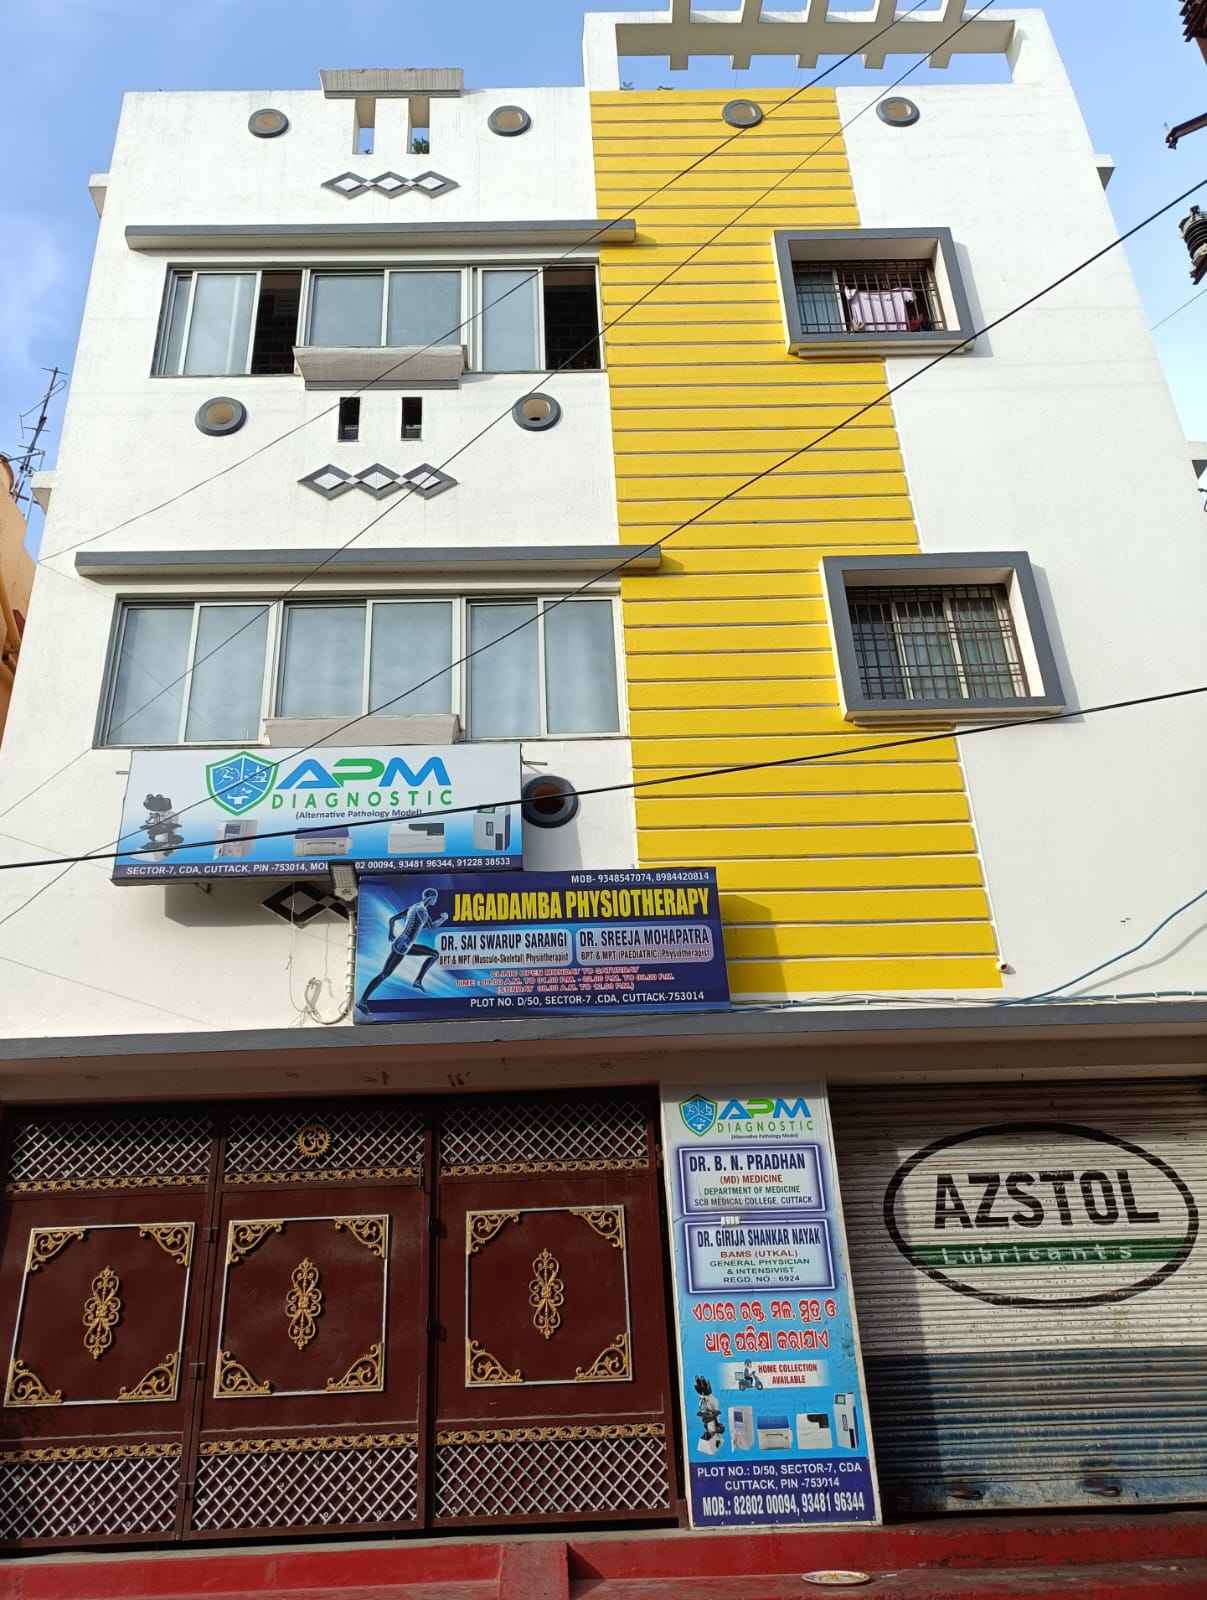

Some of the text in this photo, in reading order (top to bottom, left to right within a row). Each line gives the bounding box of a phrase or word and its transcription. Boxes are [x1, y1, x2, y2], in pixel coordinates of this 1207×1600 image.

[276, 756, 452, 789] APM
[272, 790, 453, 810] DIAGNOSTIC
[295, 810, 346, 820] (Alternative
[348, 810, 390, 819] Pathology
[126, 866, 176, 876] SECTOR-7,
[252, 864, 269, 872] PIN
[270, 862, 308, 872] -753014,
[368, 861, 396, 870] 00094,
[398, 860, 424, 869] 93481
[426, 859, 455, 868] 96344,
[456, 858, 483, 867] 91228
[484, 857, 511, 866] 38533
[571, 872, 709, 884] MOB- 9348547074, 8984420814
[452, 888, 708, 922] JAGADAMBA PHYSIOTHERAPY
[440, 932, 567, 951] DR. SAI SWARUP SARANGI
[580, 928, 710, 946] DR. SREEJA MOHAPATRA
[470, 998, 495, 1008] PLOT
[497, 997, 514, 1007] NO.
[517, 996, 542, 1006] D/50,
[545, 994, 592, 1005] SECTOR-7
[622, 992, 704, 1002] CUTTACK-753014
[718, 1097, 812, 1120] APM
[717, 1120, 814, 1133] DIAGNOSTIC
[689, 1153, 806, 1172] DR. B. N. PRADHAN
[720, 1174, 784, 1185] (MD) MEDICINE
[704, 1185, 801, 1196] DEPARTMENT OF MEDICINE
[710, 1197, 743, 1206] MEDICAL
[780, 1196, 813, 1204] CUTTACK
[934, 1169, 1160, 1230] AZSTOL
[697, 1227, 822, 1248] DR. GIRIJA SHANKAR NAYAK
[720, 1250, 798, 1258] BAMS (UTKAL)
[940, 1244, 1133, 1266] Lubricants
[710, 1258, 810, 1268] GENERAL PHYSICIAN
[736, 1266, 795, 1275] INTENSIVIST
[693, 1302, 737, 1321] ଏଠାରେ
[704, 1332, 732, 1357] ଧାତୁ
[758, 1363, 818, 1374] HOME COLLECTION
[772, 1374, 806, 1384] AVAILABLE
[697, 1462, 863, 1478] PLOT NO.: D/50, SECTOR-7, CDA
[724, 1476, 840, 1490] CUTTACK, PIN -753014
[702, 1492, 864, 1516] MOB.: 82802 00094, 93481 96344
